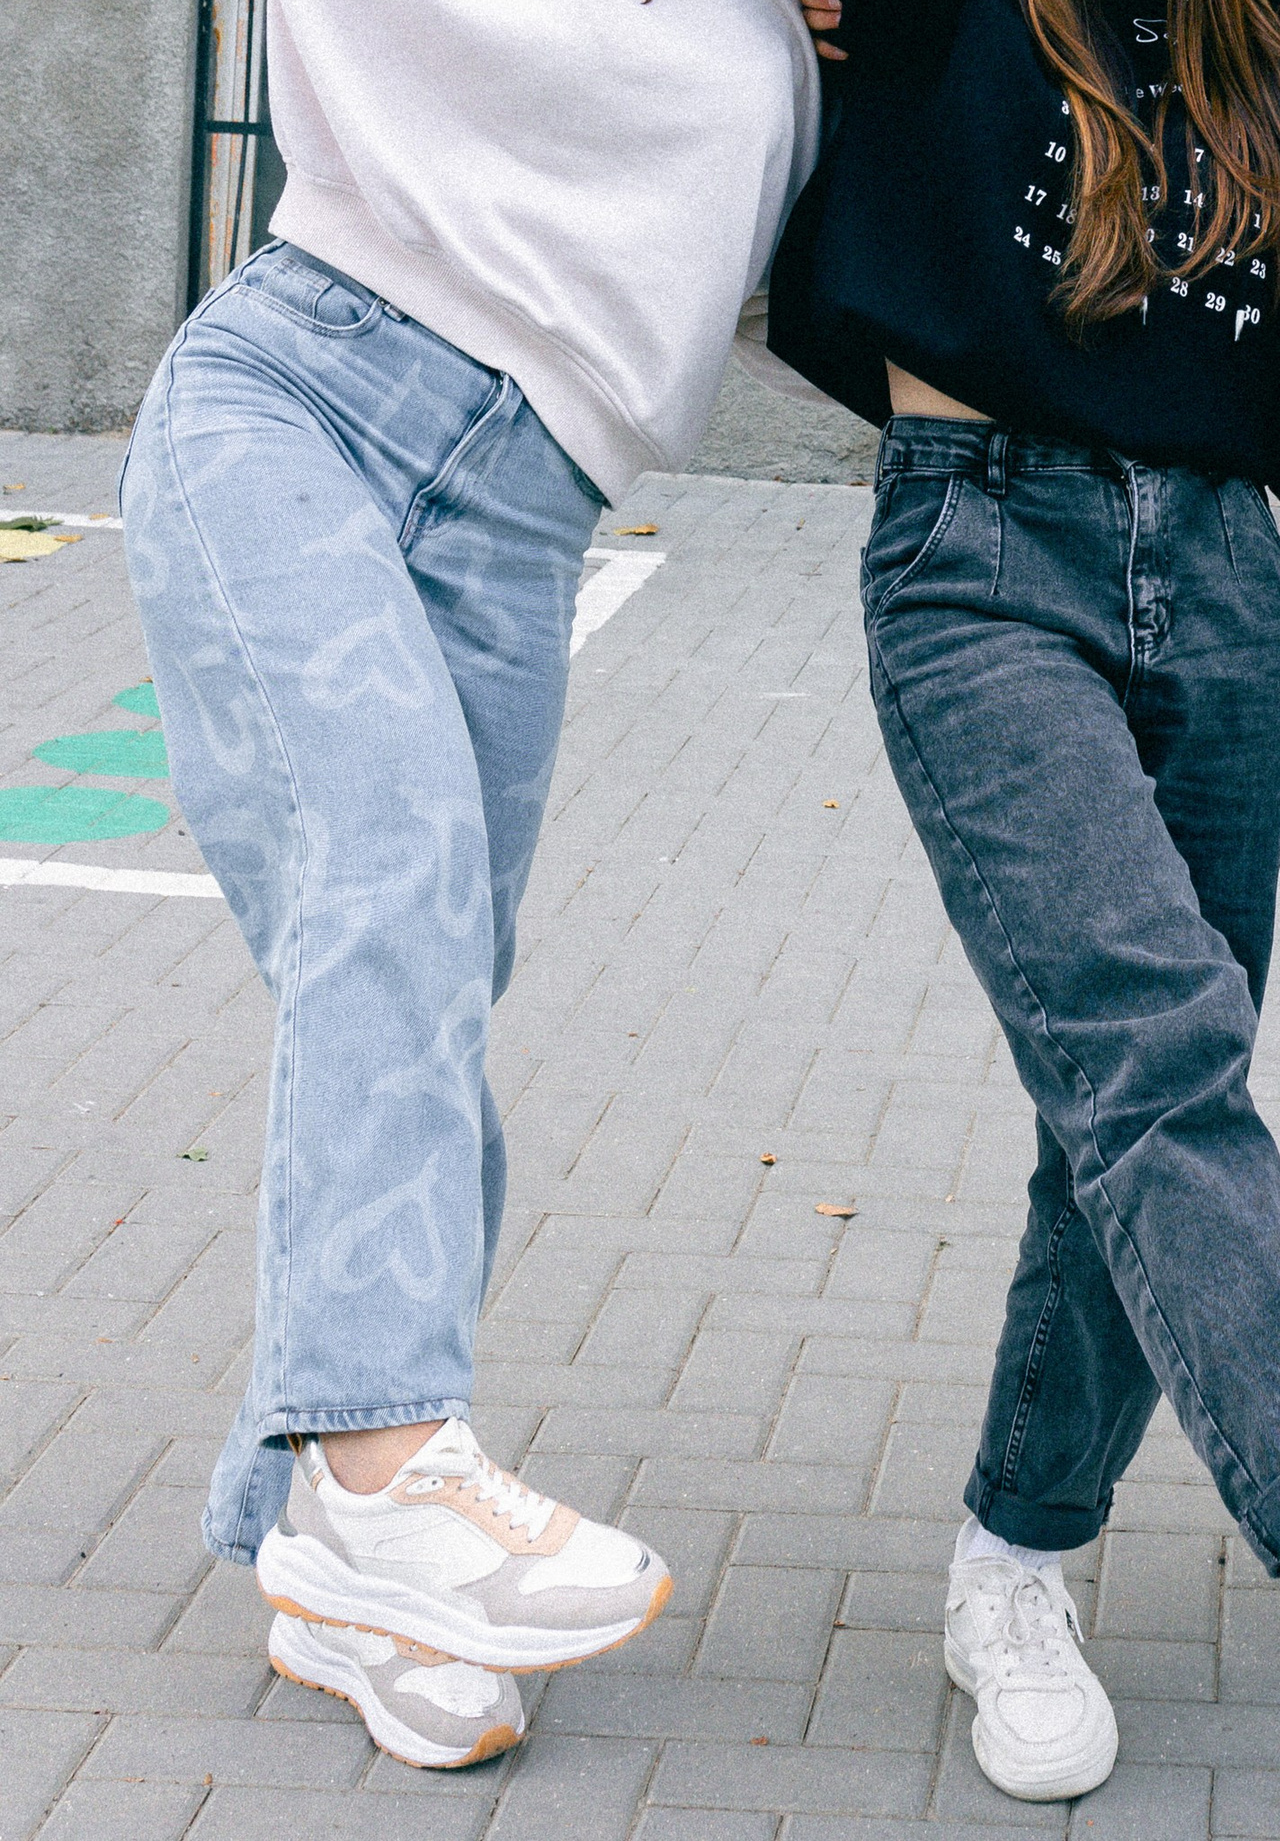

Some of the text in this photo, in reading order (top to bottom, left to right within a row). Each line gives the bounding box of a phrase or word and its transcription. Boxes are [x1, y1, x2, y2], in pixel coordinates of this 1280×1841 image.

[1044, 141, 1067, 163] 10
[1141, 185, 1160, 201] 13
[1183, 189, 1204, 209] 14
[1194, 147, 1205, 163] 7
[1024, 184, 1048, 206] 17
[1056, 203, 1077, 225] 18
[1177, 232, 1194, 253] 21
[1214, 247, 1236, 267] 22
[1249, 258, 1267, 280] 23
[1013, 225, 1260, 325] 24 25 28 29 30
